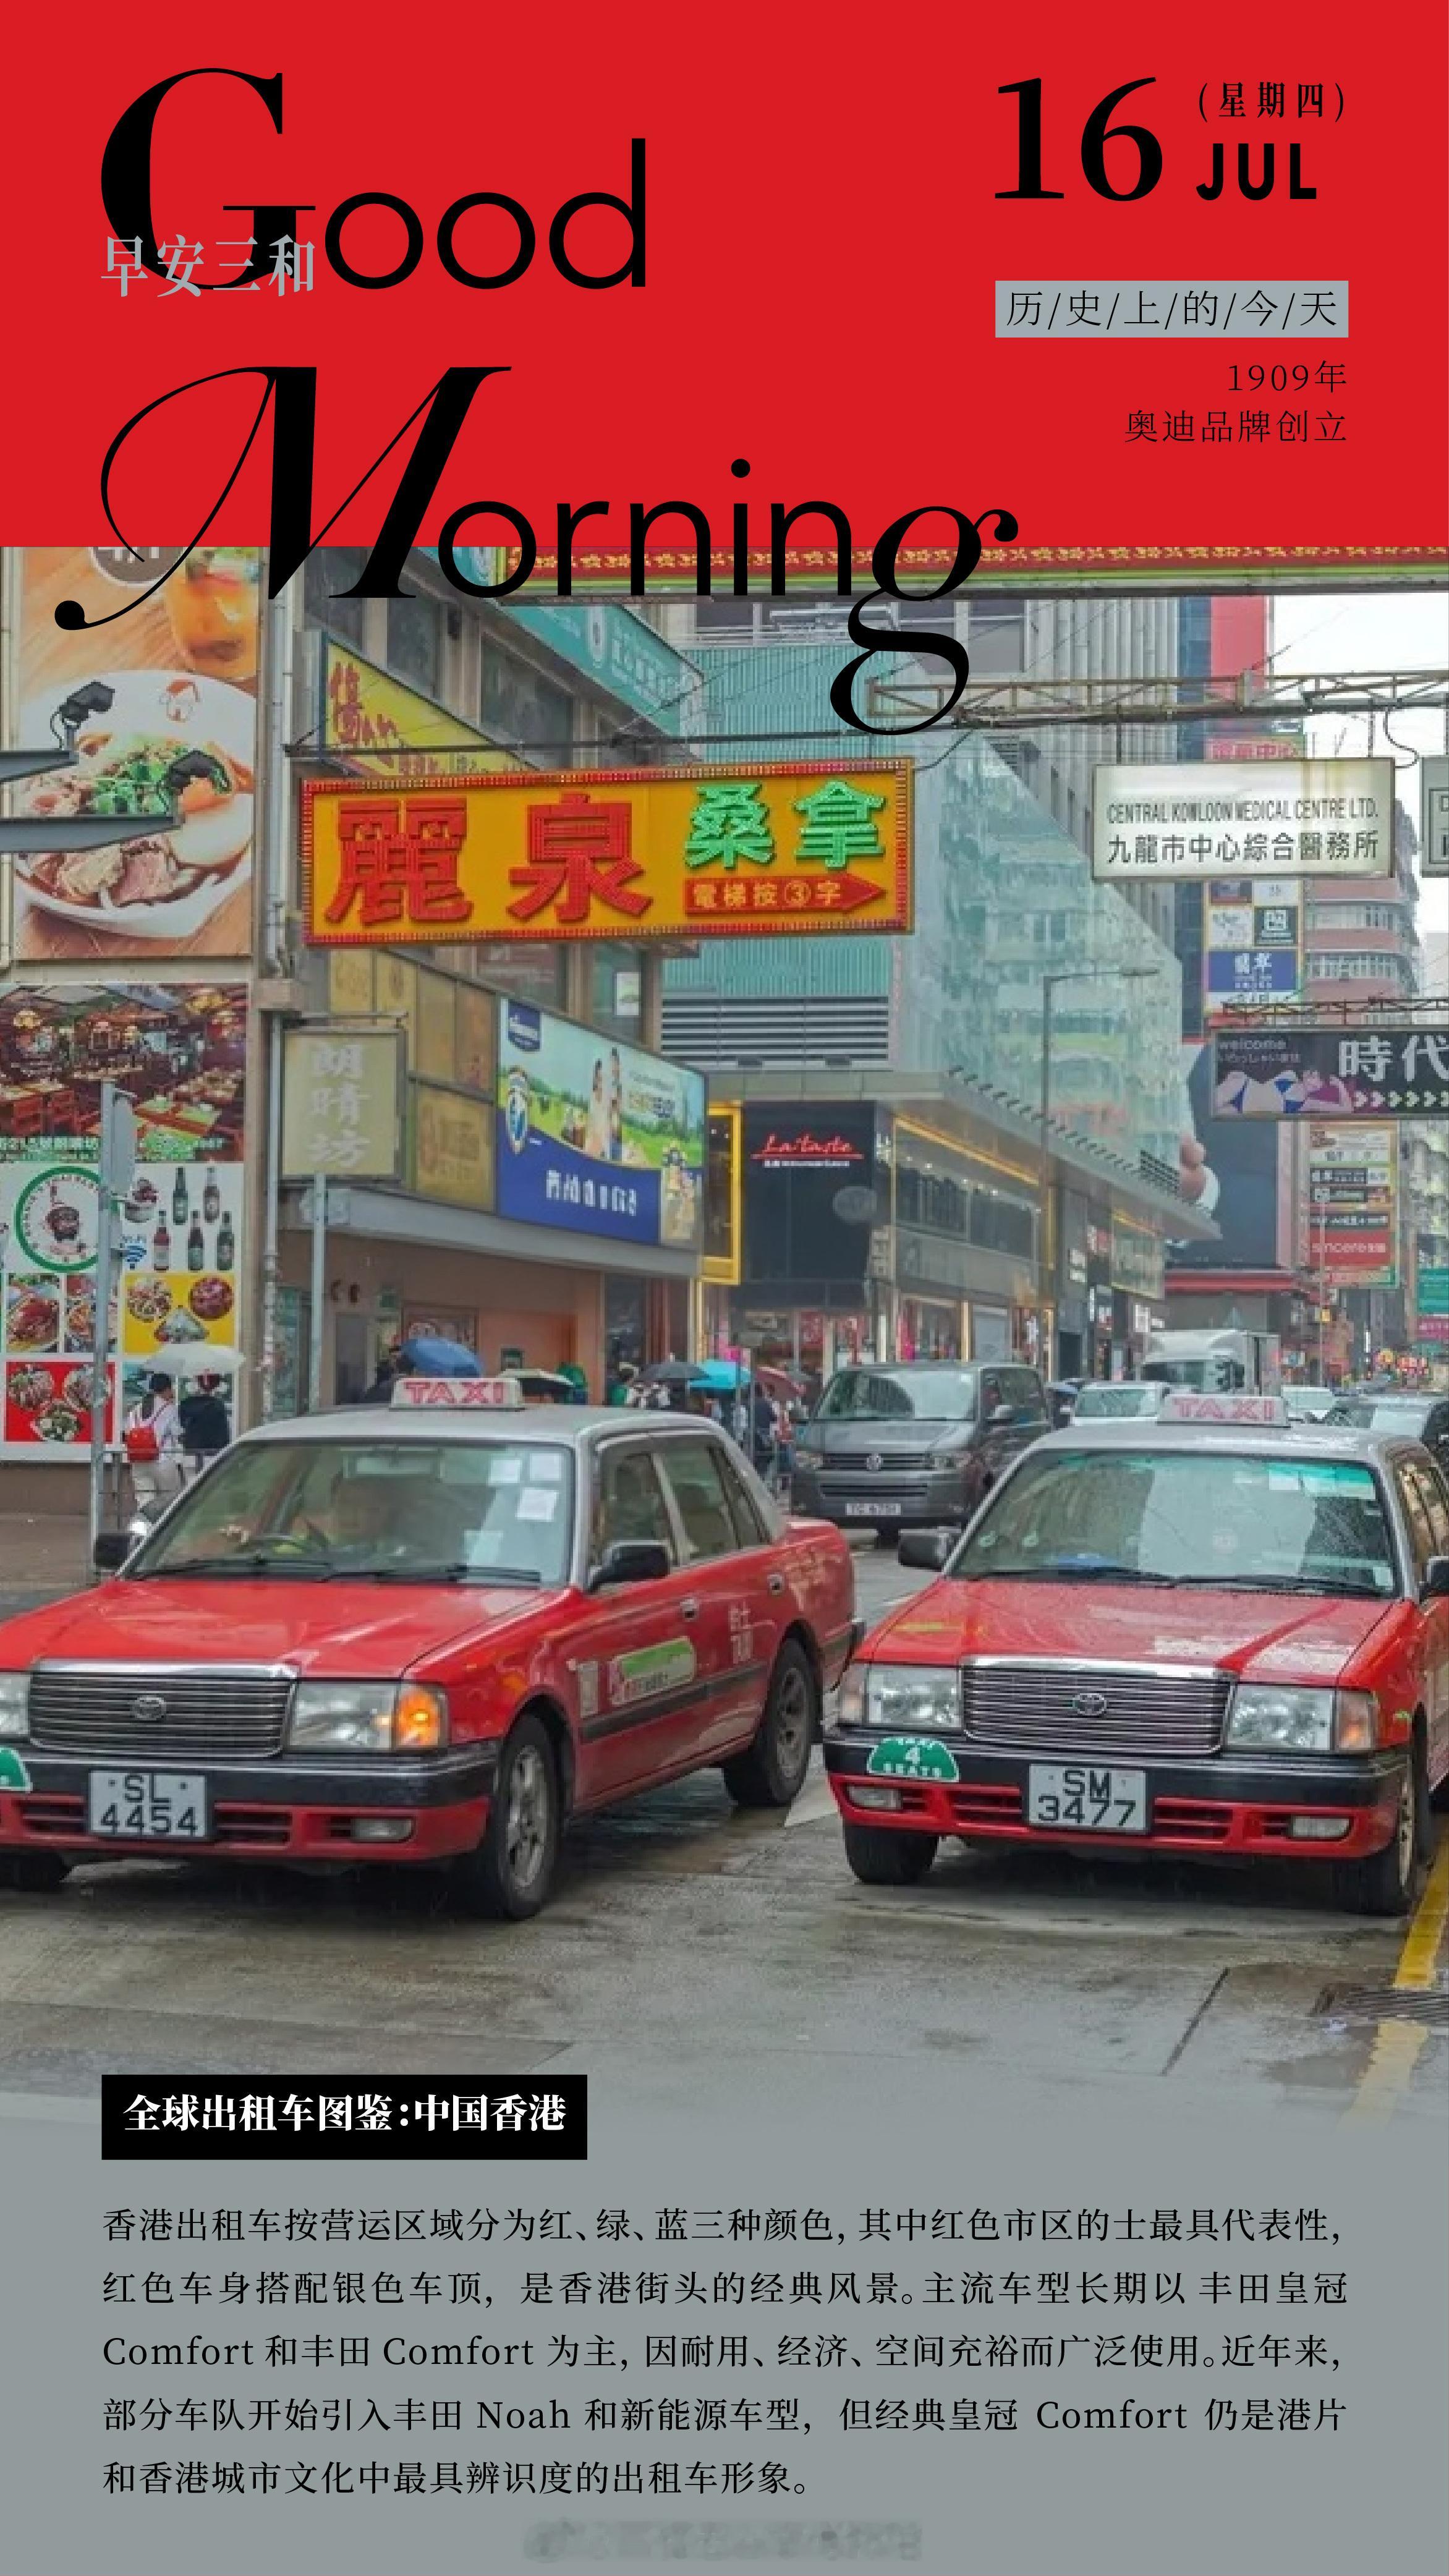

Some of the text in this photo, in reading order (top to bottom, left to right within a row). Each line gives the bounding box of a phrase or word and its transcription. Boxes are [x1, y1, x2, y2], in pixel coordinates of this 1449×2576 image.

[684, 780, 885, 869] 桑拿
[1107, 797, 1379, 823] CENTRAL KOWLOON MEDICAL CENTRE LTD.
[325, 793, 652, 925] 麗泉
[1108, 830, 1379, 865] 九龍市中心綜合醫務所
[404, 1382, 504, 1404] TAXI
[1173, 1398, 1275, 1419] TAXI
[904, 1746, 921, 1765] 4
[124, 1774, 170, 1804] SL
[1063, 1770, 1110, 1798] SM
[100, 1804, 197, 1835] 4454
[1038, 1795, 1137, 1827] 3477
